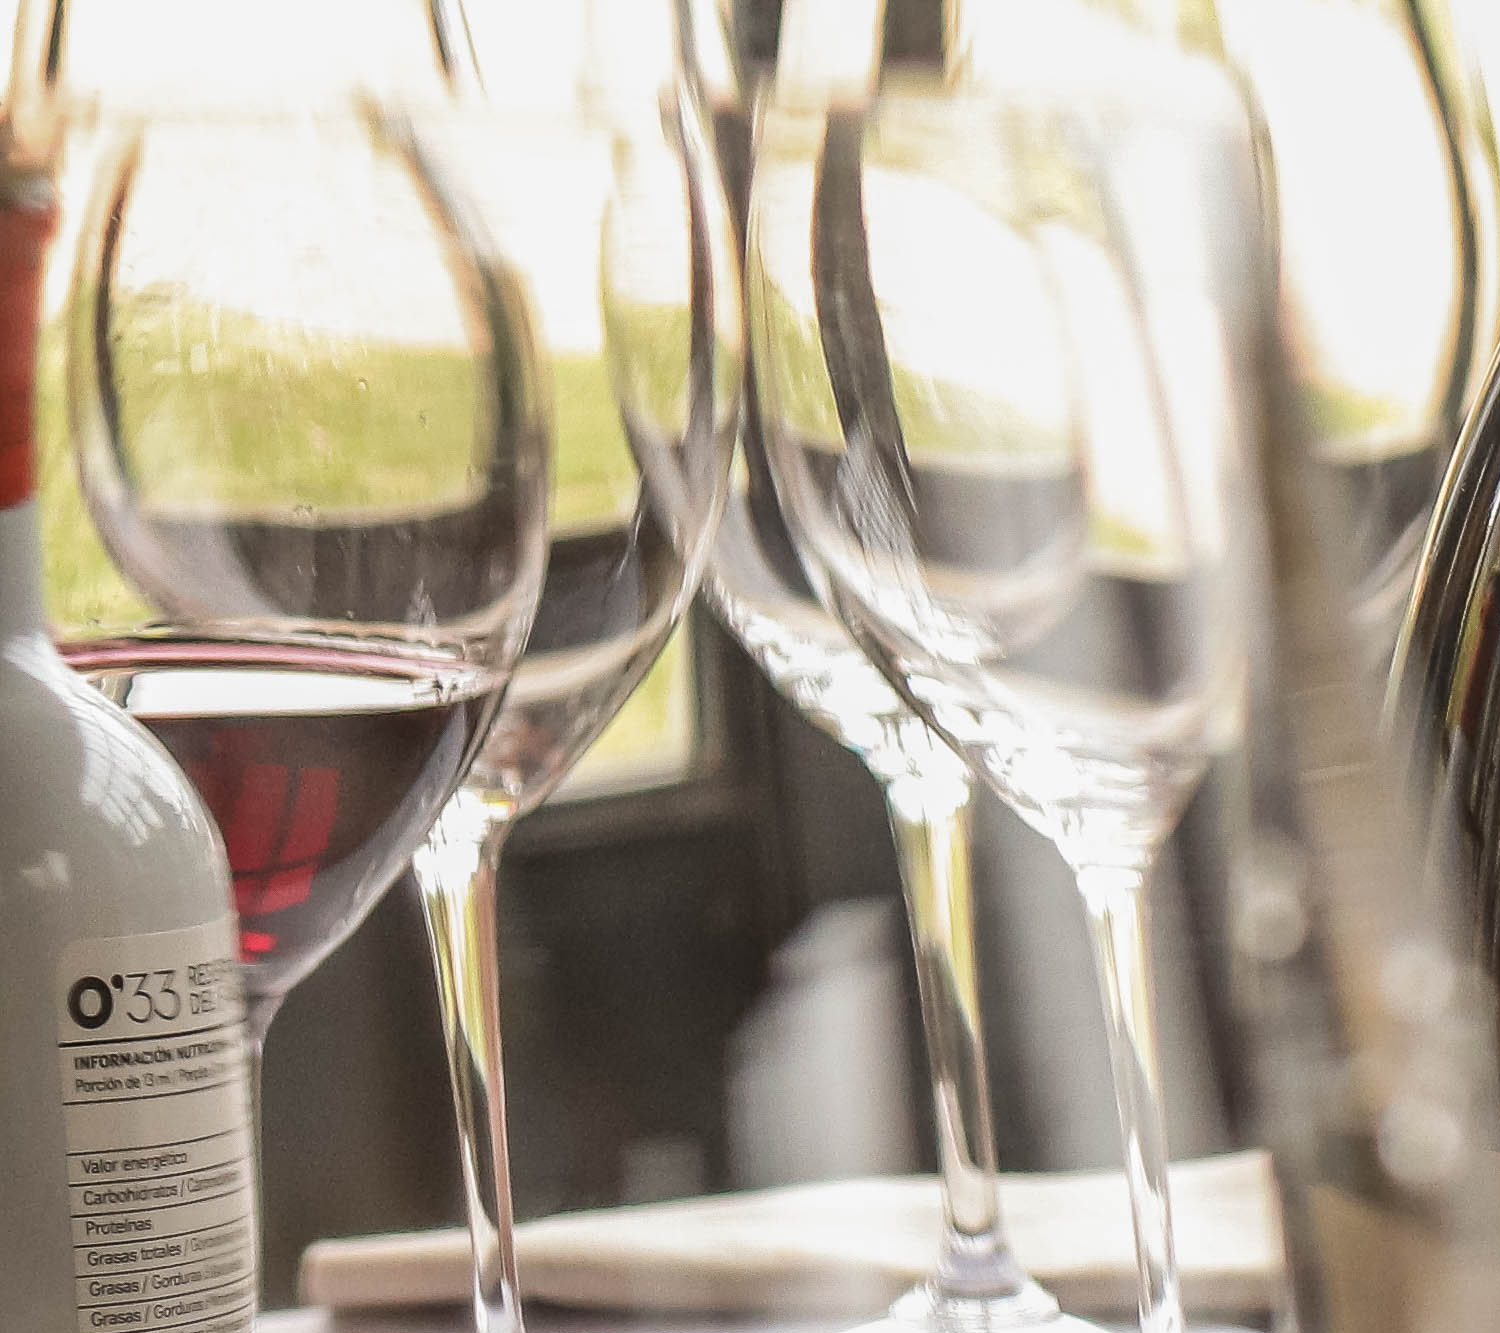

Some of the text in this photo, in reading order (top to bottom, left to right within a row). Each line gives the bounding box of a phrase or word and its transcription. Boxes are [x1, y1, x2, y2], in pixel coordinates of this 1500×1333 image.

[82, 1158, 118, 1175] Valor
[87, 1249, 138, 1267] Grasas
[89, 1279, 140, 1297] Grasas
[91, 1309, 142, 1327] Grasas
